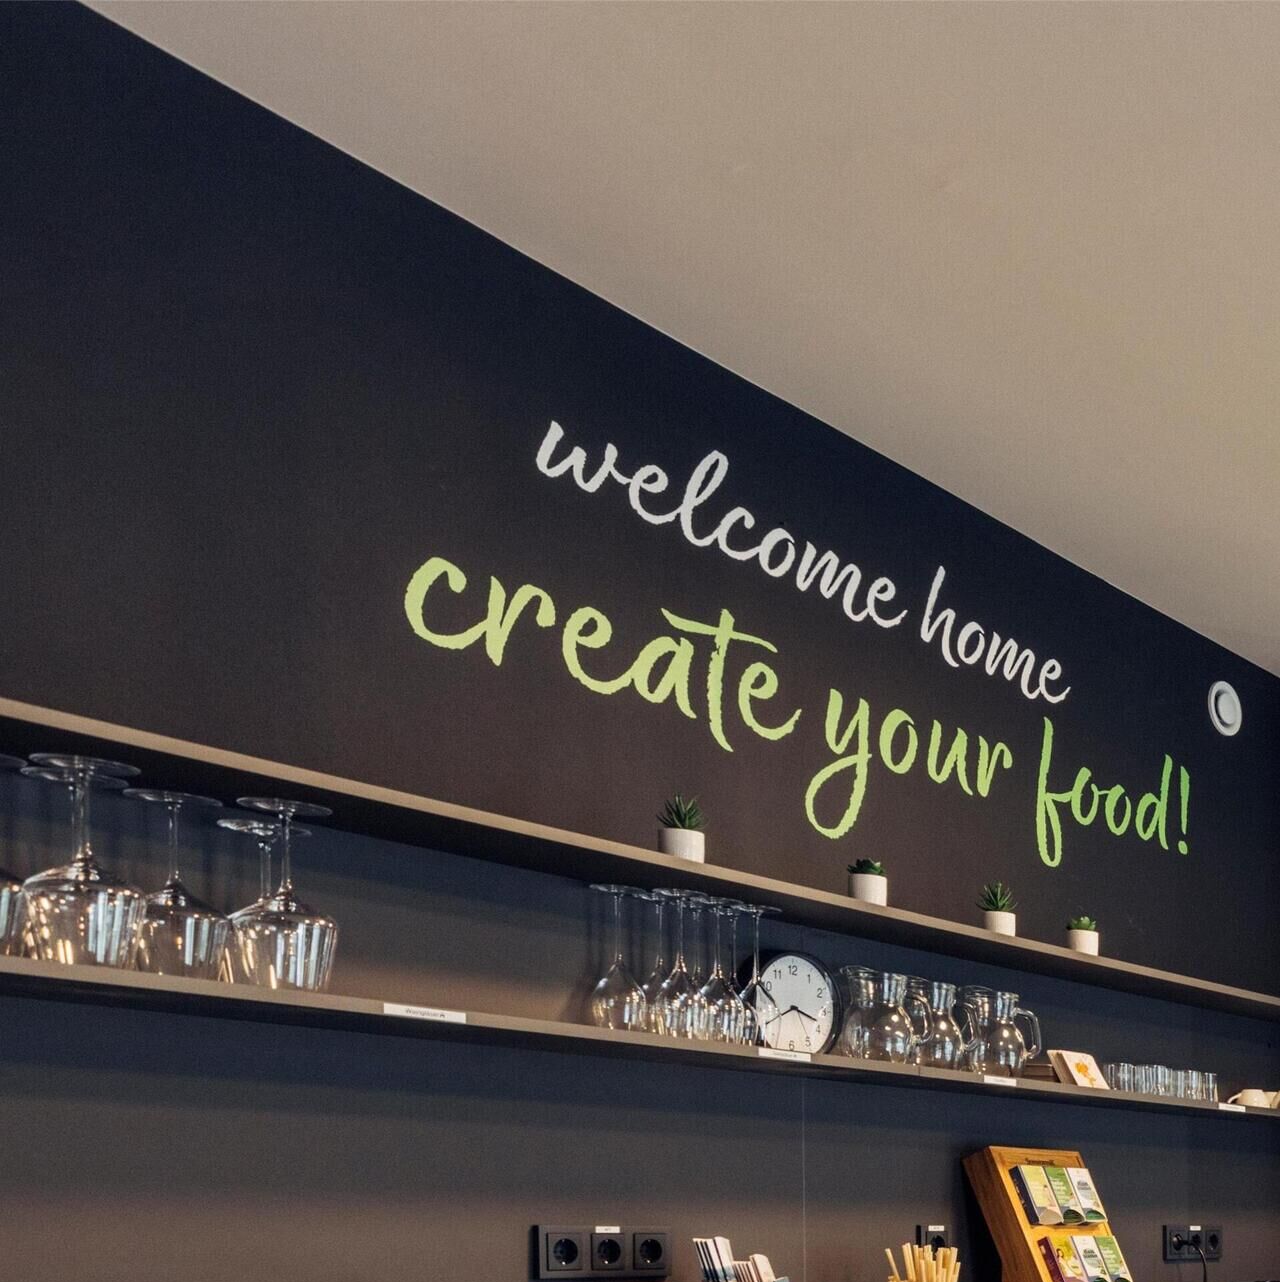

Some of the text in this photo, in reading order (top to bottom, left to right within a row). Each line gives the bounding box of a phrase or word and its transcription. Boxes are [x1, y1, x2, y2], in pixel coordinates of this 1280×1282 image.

[535, 420, 1071, 703] welcome home
[404, 556, 1190, 868] create your food!
[773, 969, 782, 979] 11
[788, 965, 798, 976] 12
[816, 988, 823, 998] 2
[789, 1040, 795, 1051] 6
